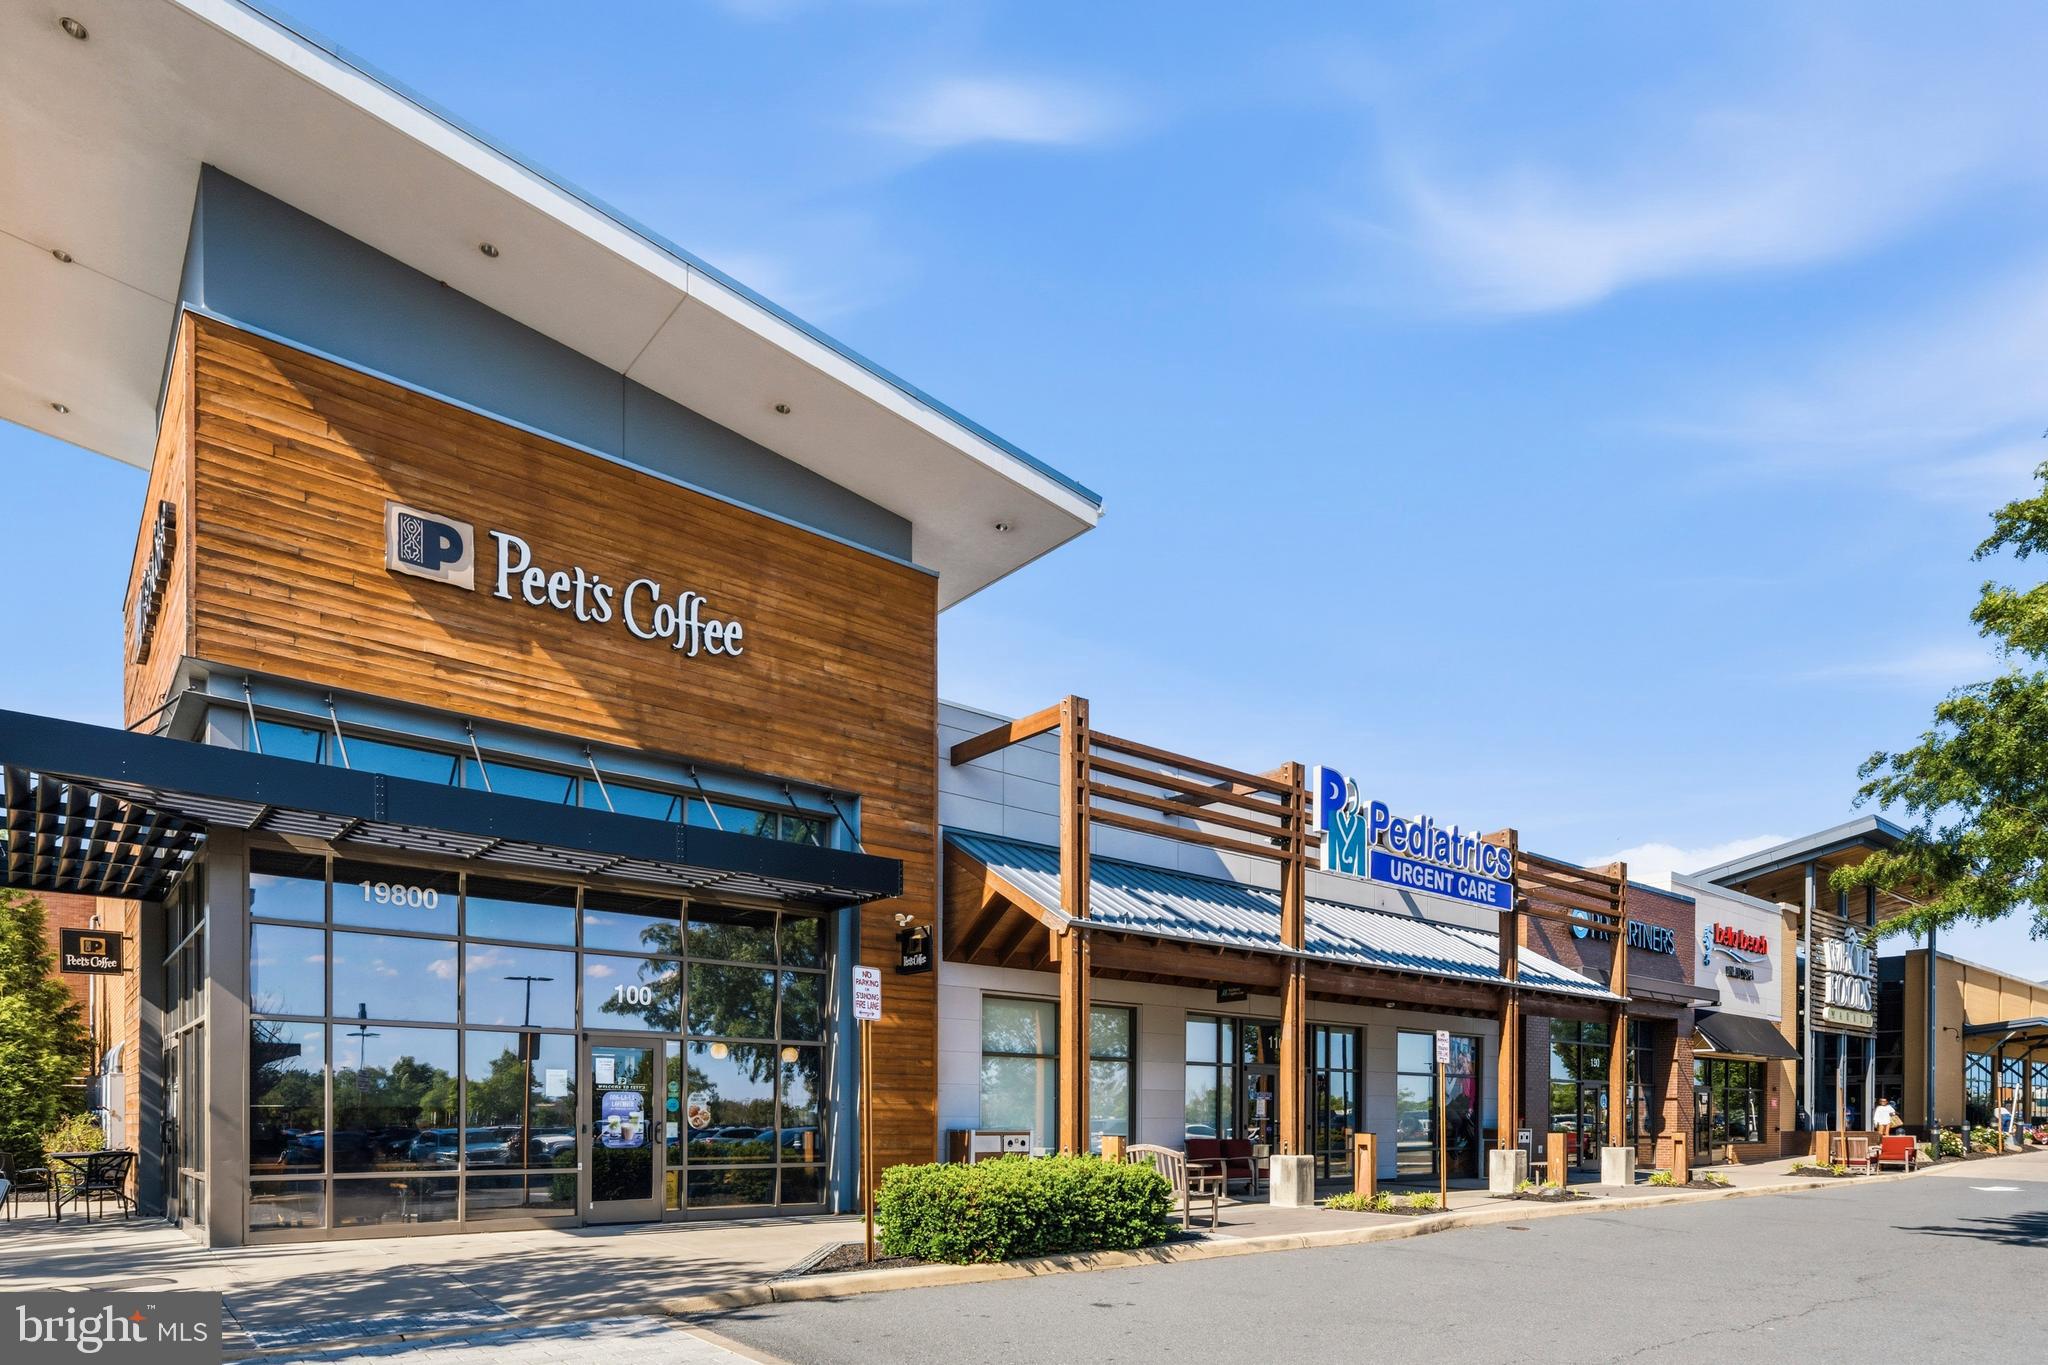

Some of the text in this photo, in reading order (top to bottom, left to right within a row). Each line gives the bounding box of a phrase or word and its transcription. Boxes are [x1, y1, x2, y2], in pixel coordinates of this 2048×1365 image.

[488, 529, 744, 658] Peet's Coffee
[1364, 799, 1513, 880] Pediatrics
[1390, 859, 1496, 903] URGENT CARE
[359, 880, 439, 910] 19800
[90, 956, 117, 969] Coffee
[862, 970, 872, 979] NO
[614, 984, 652, 1006] 100
[855, 978, 879, 988] PARKING
[1824, 971, 1873, 1011] FOODS
[1268, 1035, 1281, 1049] 11
